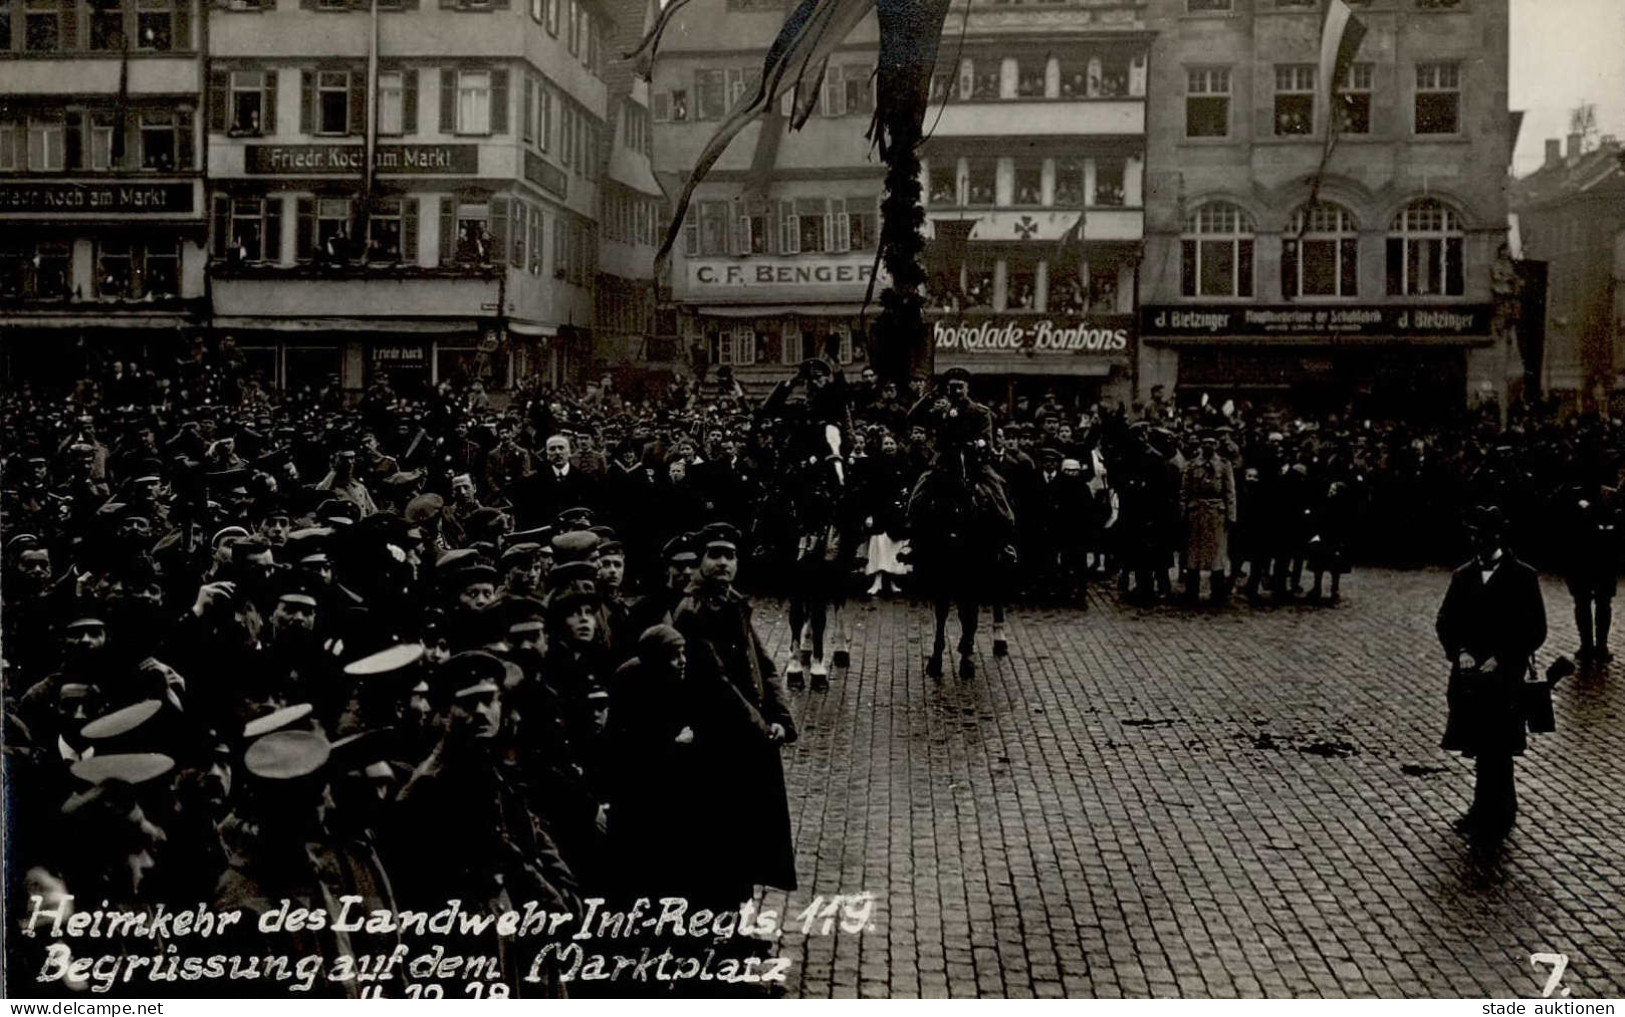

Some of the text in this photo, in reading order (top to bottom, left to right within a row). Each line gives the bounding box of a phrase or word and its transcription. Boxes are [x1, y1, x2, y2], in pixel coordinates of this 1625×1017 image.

[403, 147, 451, 168] Markt
[43, 188, 84, 206] Koch
[89, 191, 114, 206] am
[119, 188, 168, 206] Markt
[697, 266, 718, 283] C.
[726, 266, 744, 283] F.
[933, 320, 1127, 350] hokolade-Bonbons
